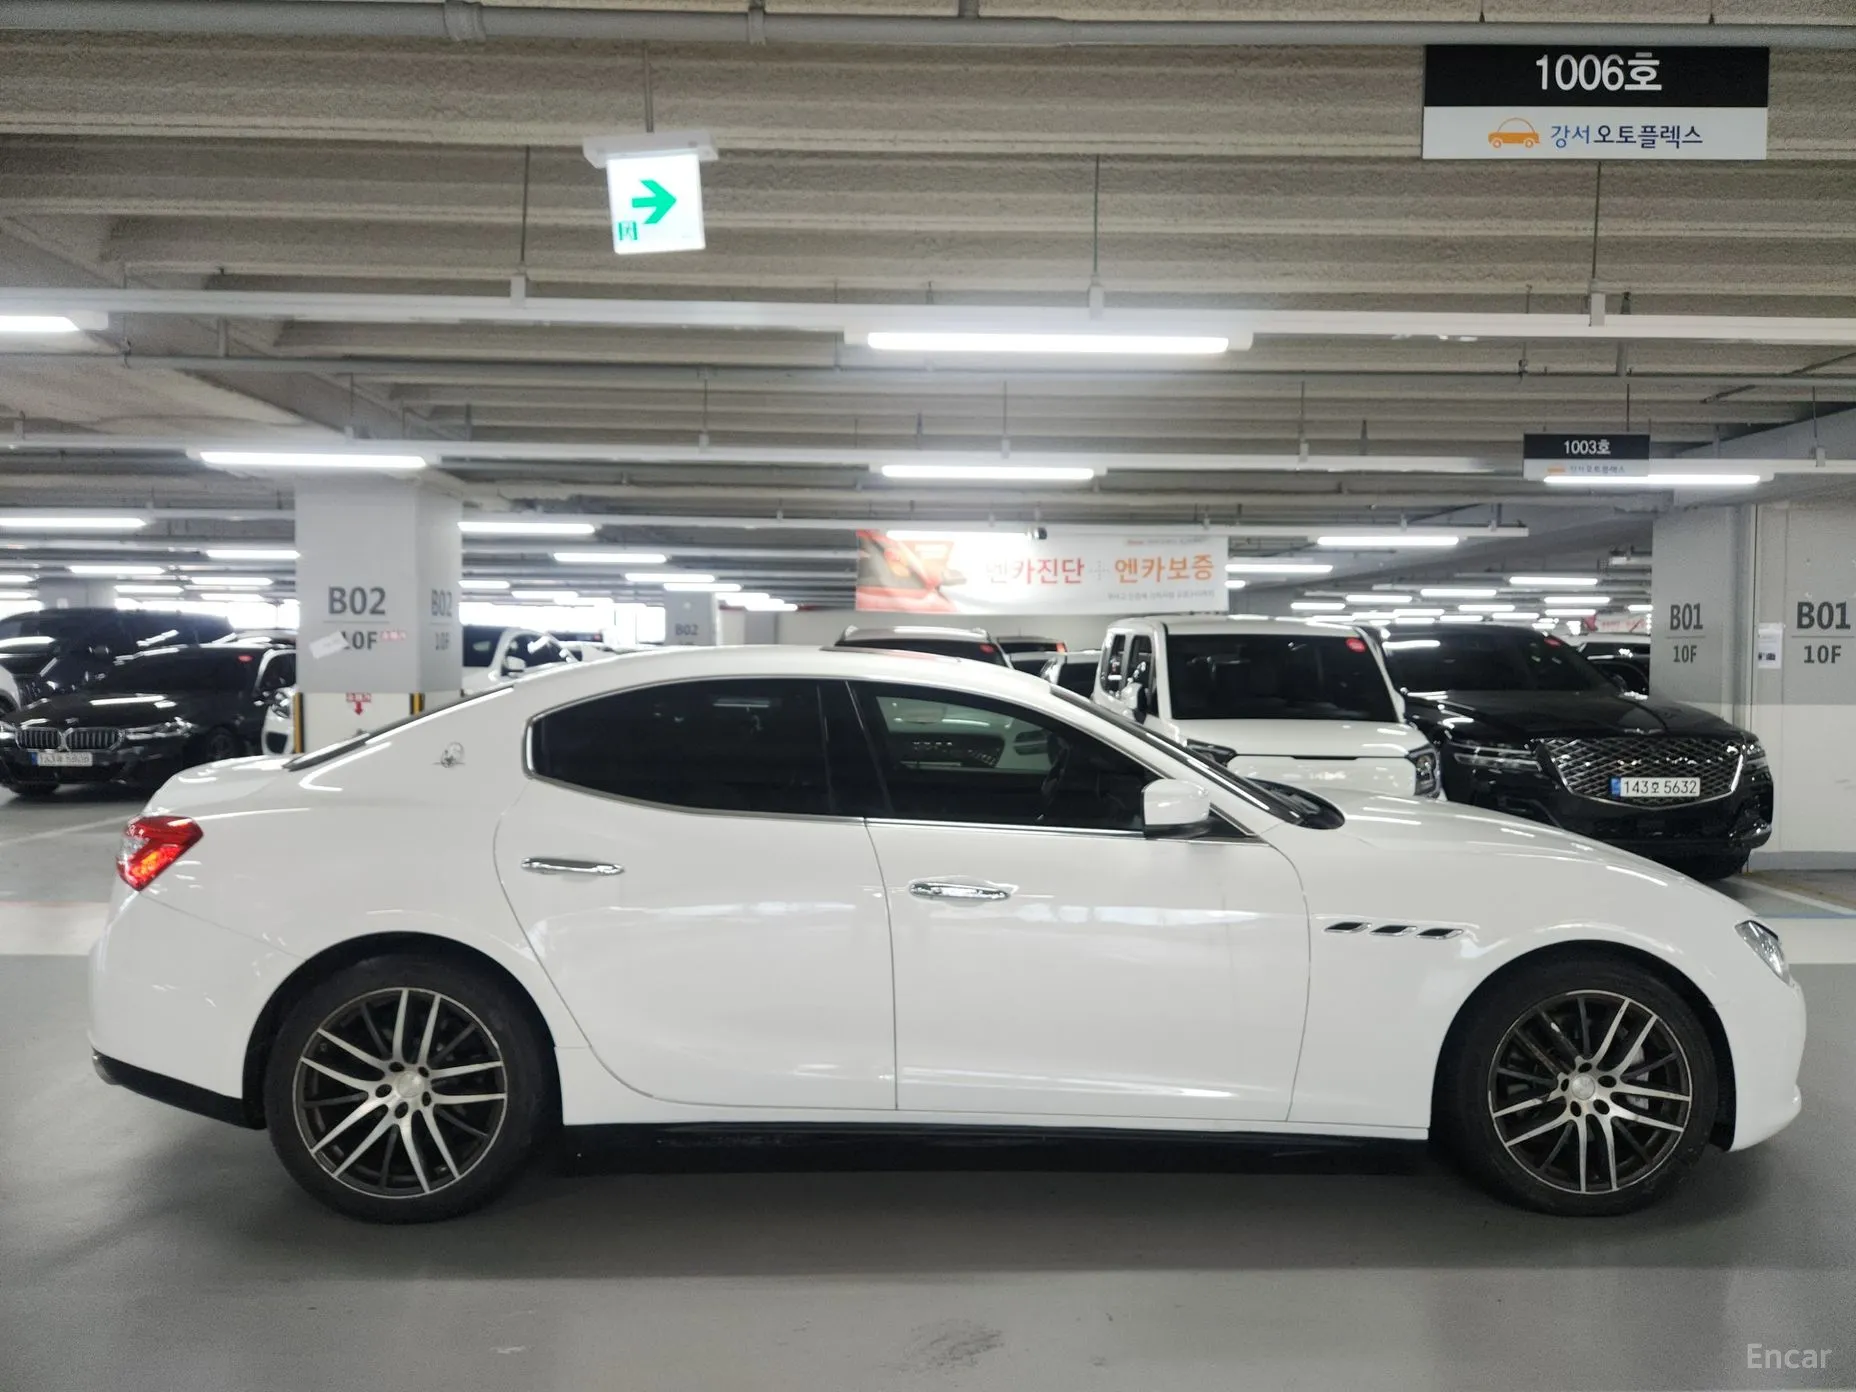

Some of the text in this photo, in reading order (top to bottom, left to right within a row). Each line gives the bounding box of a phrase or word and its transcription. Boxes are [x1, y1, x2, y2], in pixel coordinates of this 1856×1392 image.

[1535, 51, 1663, 92] 1006호
[1563, 438, 1611, 455] 1003호
[1114, 553, 1215, 583] 엔카보증
[328, 586, 386, 615] B02
[431, 588, 453, 617] B02
[1669, 603, 1704, 631] B01
[1796, 601, 1852, 630] B01
[1672, 645, 1698, 664] 10F
[1803, 645, 1842, 664] 10F
[1663, 780, 1697, 794] 5632
